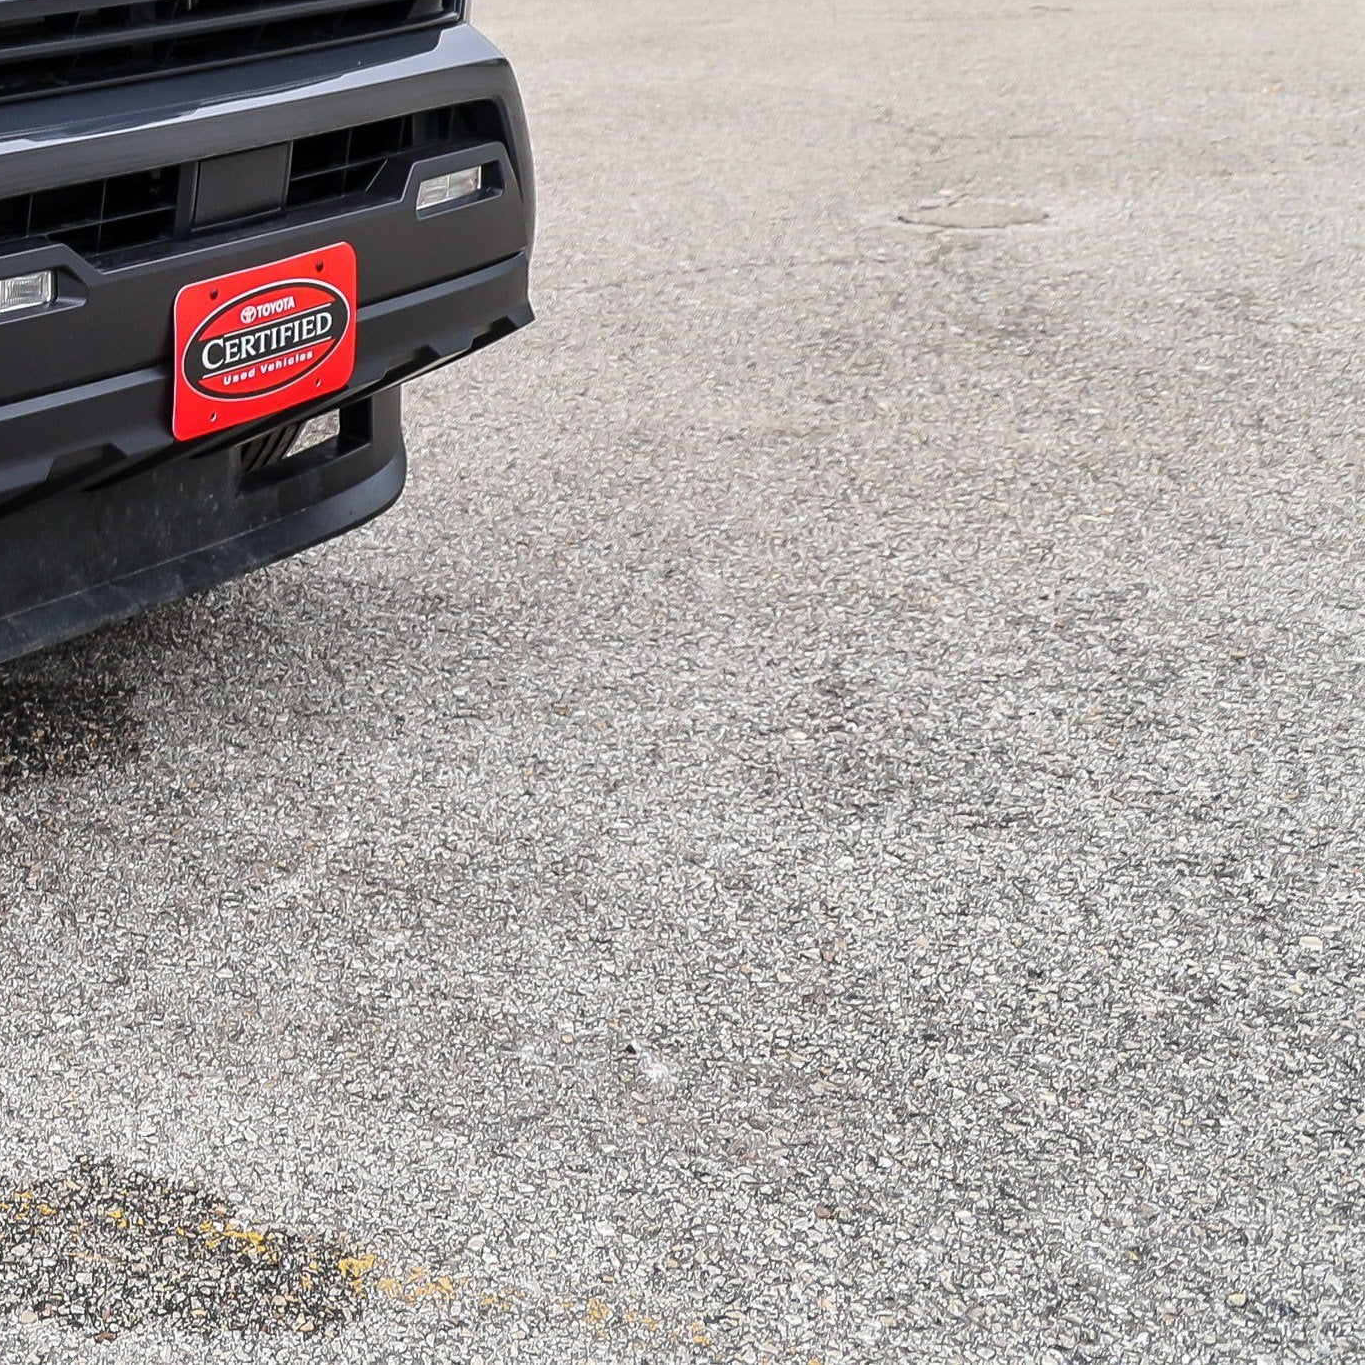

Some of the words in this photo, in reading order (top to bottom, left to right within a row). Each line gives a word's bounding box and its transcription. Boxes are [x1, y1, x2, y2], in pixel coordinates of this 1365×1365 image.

[257, 296, 296, 319] TOYOTA
[201, 311, 333, 370] CERTIFIED
[223, 367, 256, 386] Used
[260, 350, 314, 374] Vehicles
